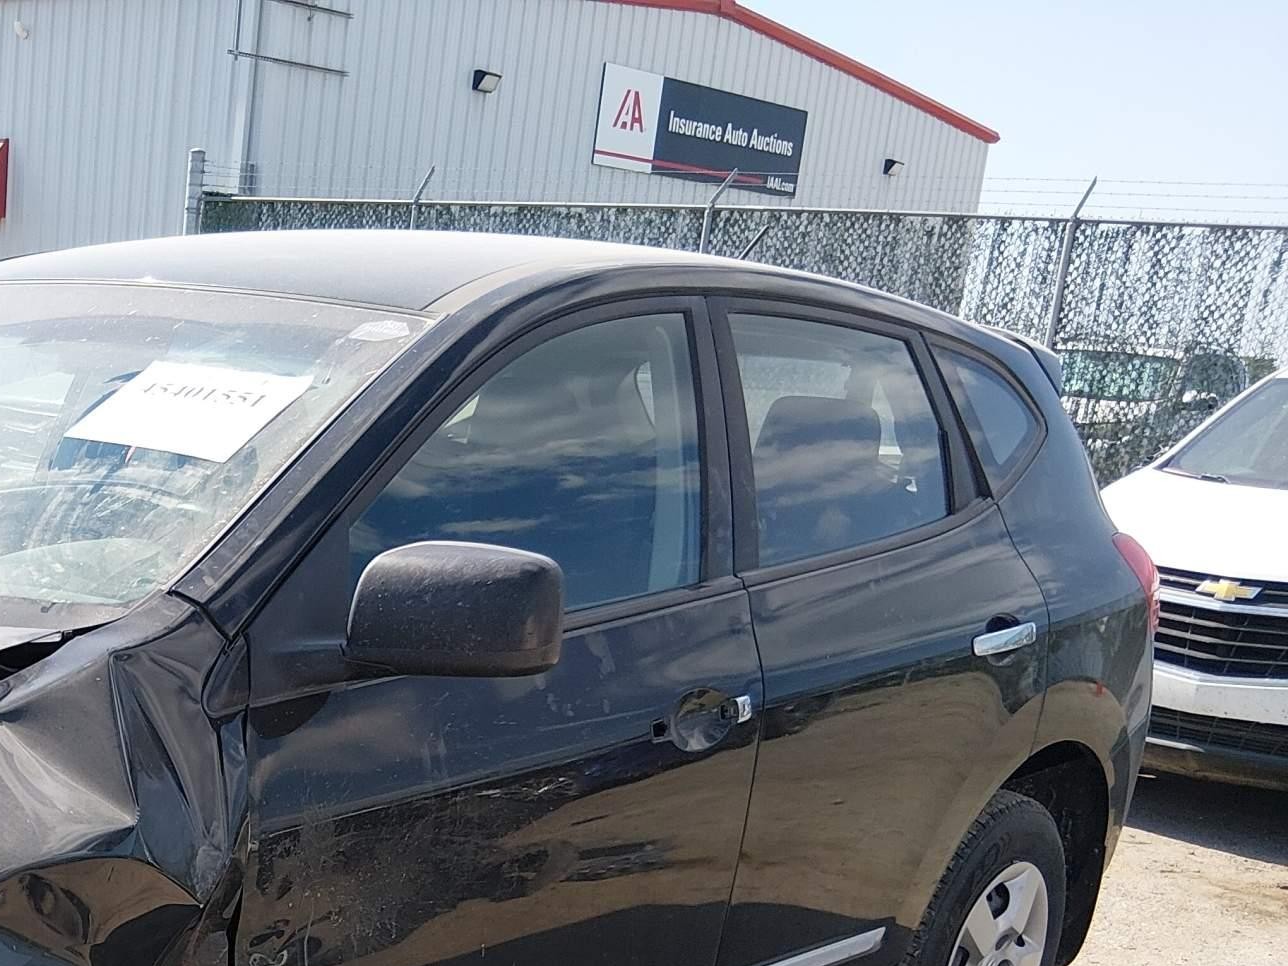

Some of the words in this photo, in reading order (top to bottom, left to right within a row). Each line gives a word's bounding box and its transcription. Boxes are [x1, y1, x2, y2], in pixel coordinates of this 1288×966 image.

[668, 110, 722, 142] Insurance
[723, 122, 748, 148] Auto
[749, 129, 794, 157] Auctions
